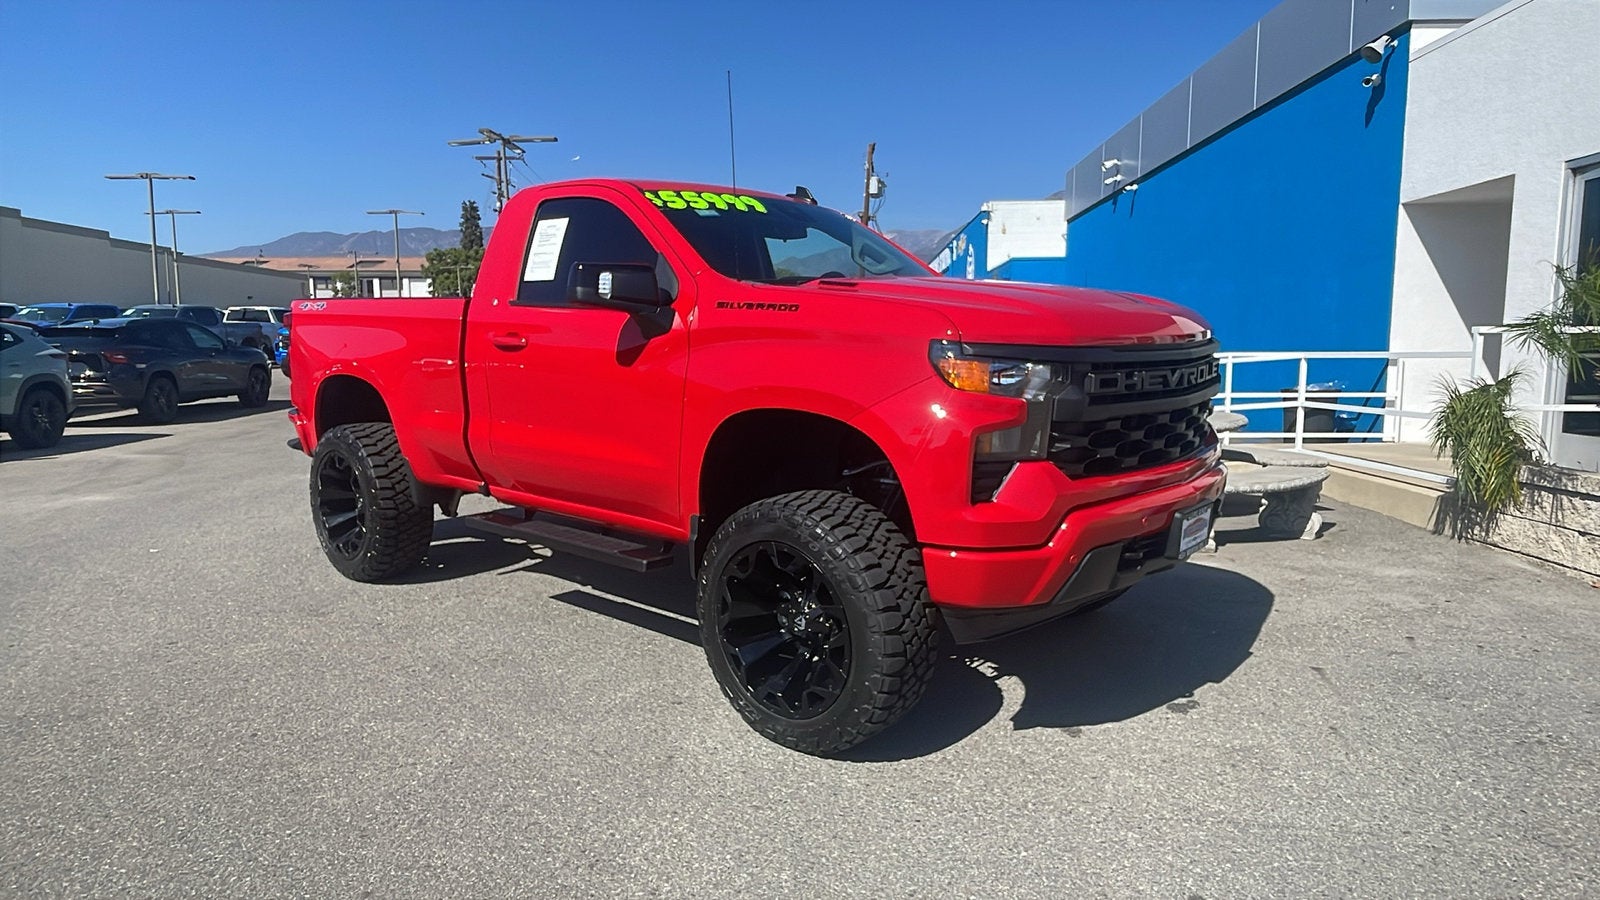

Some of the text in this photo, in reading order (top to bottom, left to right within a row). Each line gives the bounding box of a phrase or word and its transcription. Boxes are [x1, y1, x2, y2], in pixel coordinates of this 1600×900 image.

[644, 190, 768, 214] $55999
[716, 301, 800, 312] SILVERADO
[1085, 360, 1219, 393] CHEVROLE
